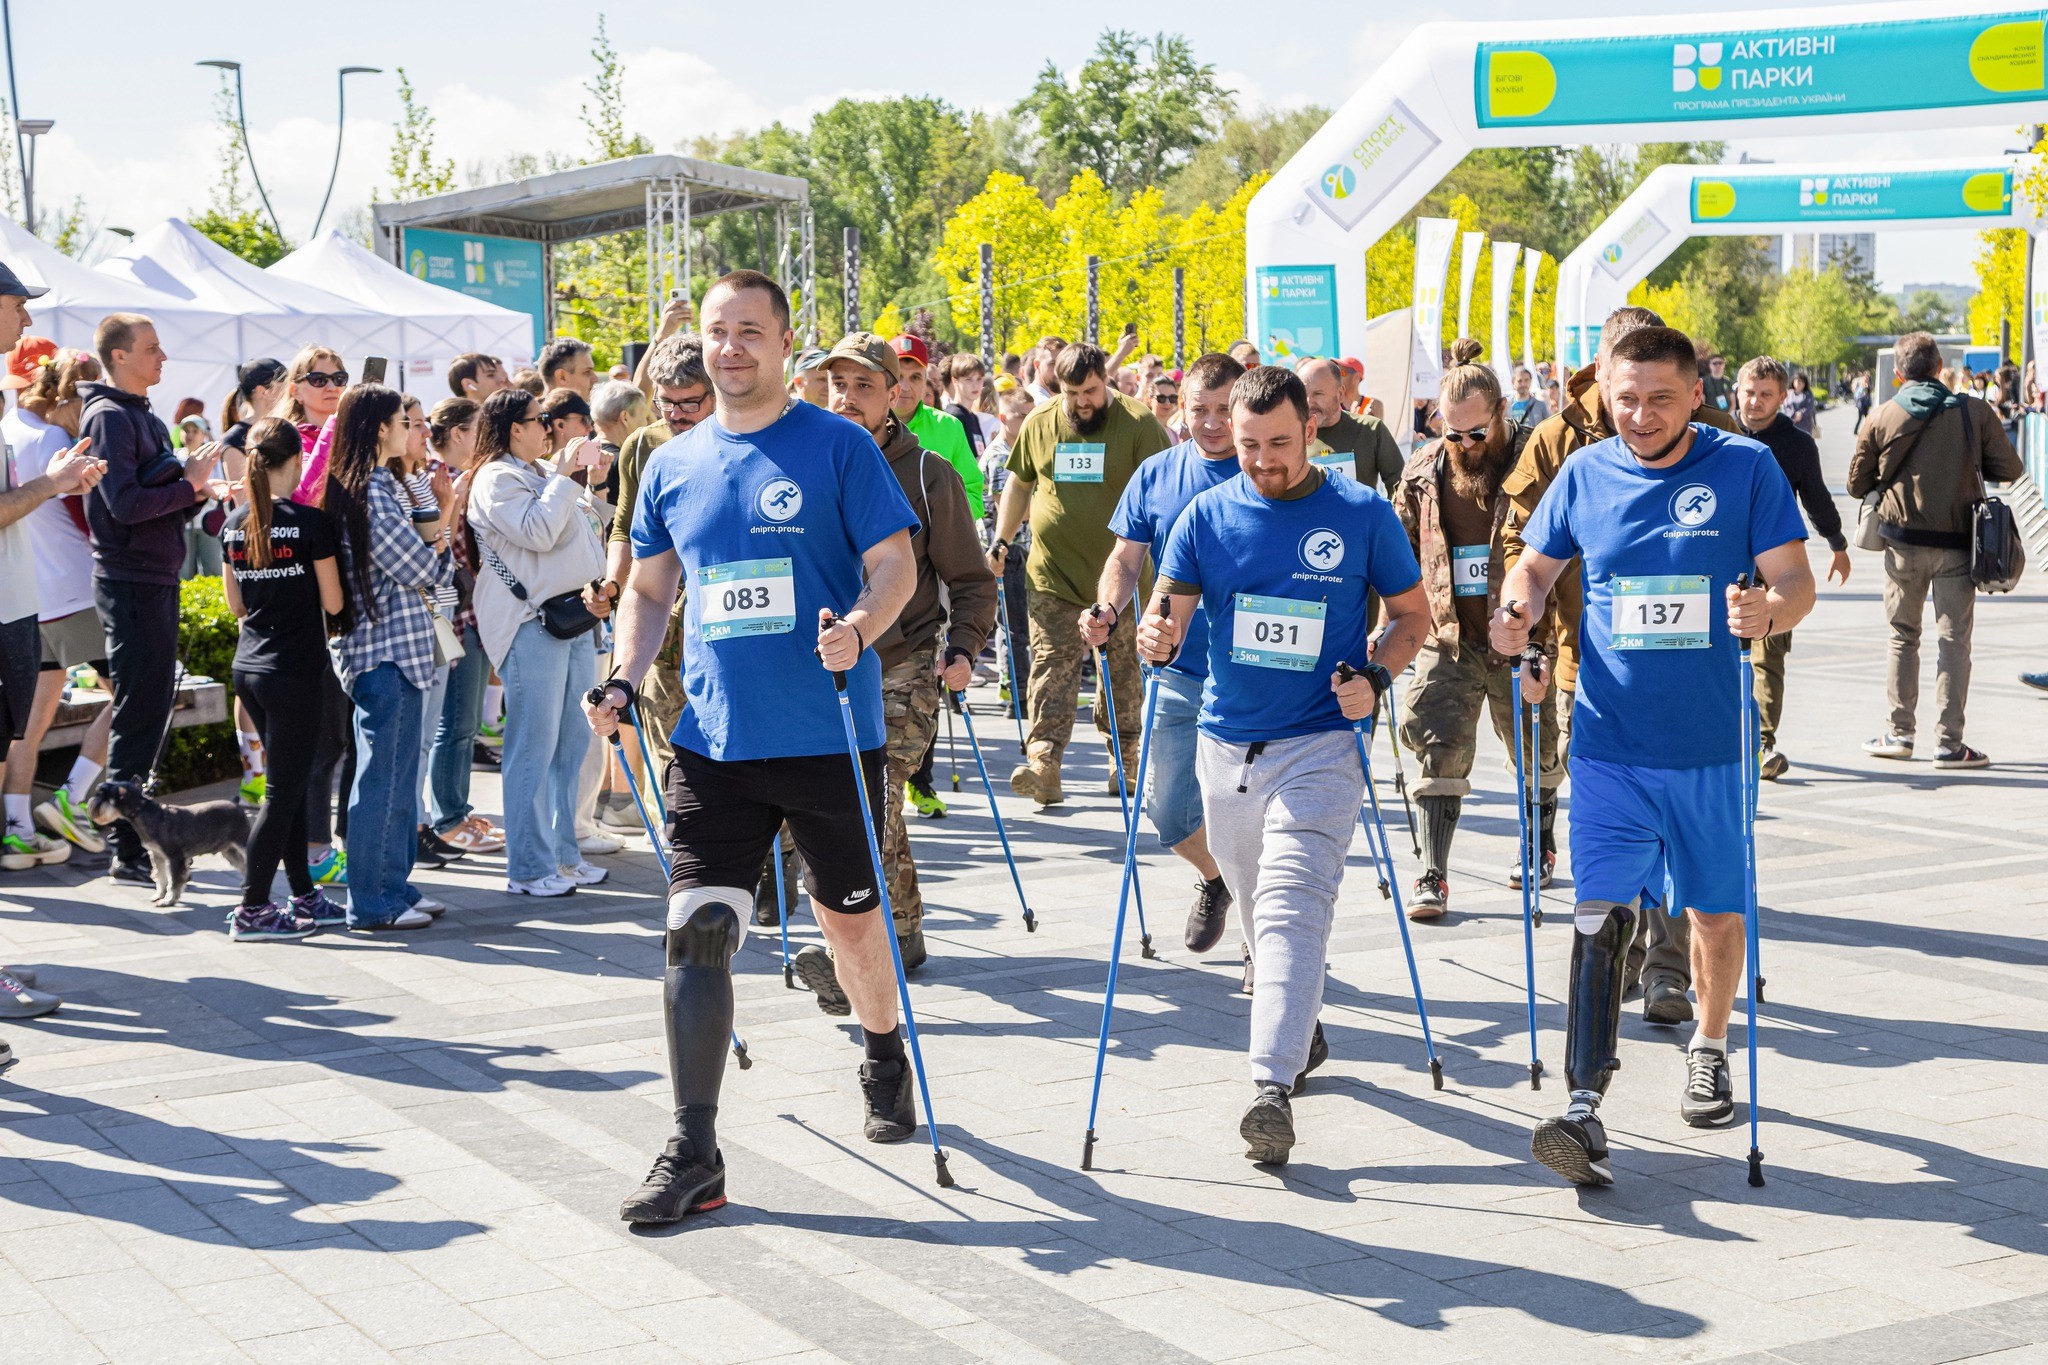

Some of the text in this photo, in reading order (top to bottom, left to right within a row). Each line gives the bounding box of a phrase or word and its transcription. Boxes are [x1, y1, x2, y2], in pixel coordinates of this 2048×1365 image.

[1731, 35, 1836, 60] АКТИВНІ
[1731, 65, 1813, 90] ПАРКИ
[1673, 92, 1846, 111] ПРОГРАМА ПРЕЗИДЕНТА УКРАЇНИ
[1353, 113, 1397, 160] СПОРТ
[1382, 122, 1407, 148] ВСІХ
[1832, 176, 1891, 190] АКТИВНІ
[1832, 192, 1878, 206] ПАРКИ
[1281, 275, 1324, 285] АКТИВНІ
[1282, 288, 1316, 298] ПАРКИ
[1069, 457, 1092, 469] 133
[750, 525, 805, 535] dnipro.protez
[1663, 530, 1719, 538] dnipro.protez
[1292, 572, 1344, 583] dnipro.protez
[1469, 562, 1489, 578] 08
[723, 586, 770, 611] 083
[1638, 603, 1685, 625] 137
[1255, 621, 1299, 645] 031
[850, 888, 871, 898] NIKE
